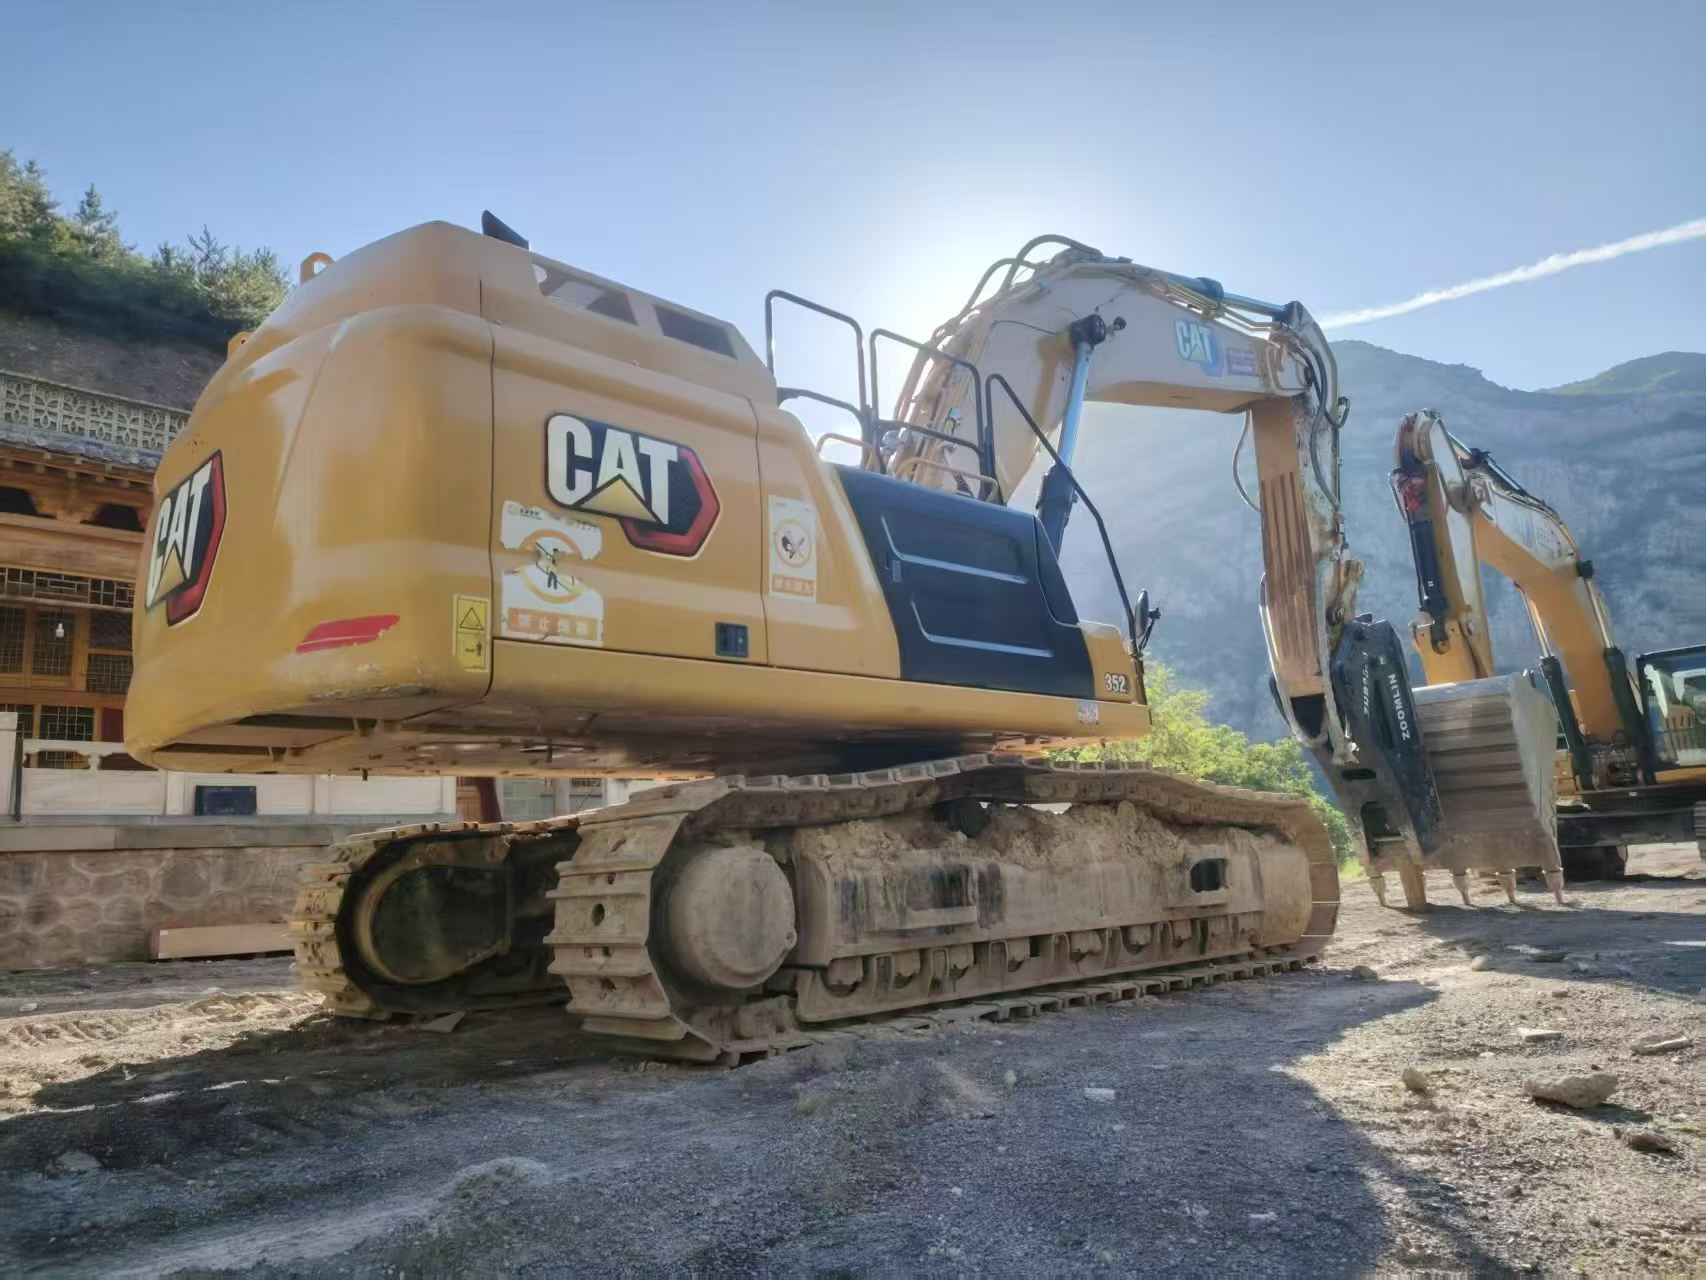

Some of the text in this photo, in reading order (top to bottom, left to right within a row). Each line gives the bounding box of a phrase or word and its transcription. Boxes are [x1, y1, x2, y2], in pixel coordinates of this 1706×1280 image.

[1175, 319, 1213, 366] CAT
[547, 415, 678, 525] CAT
[146, 460, 212, 608] CAT
[1104, 673, 1126, 693] 352
